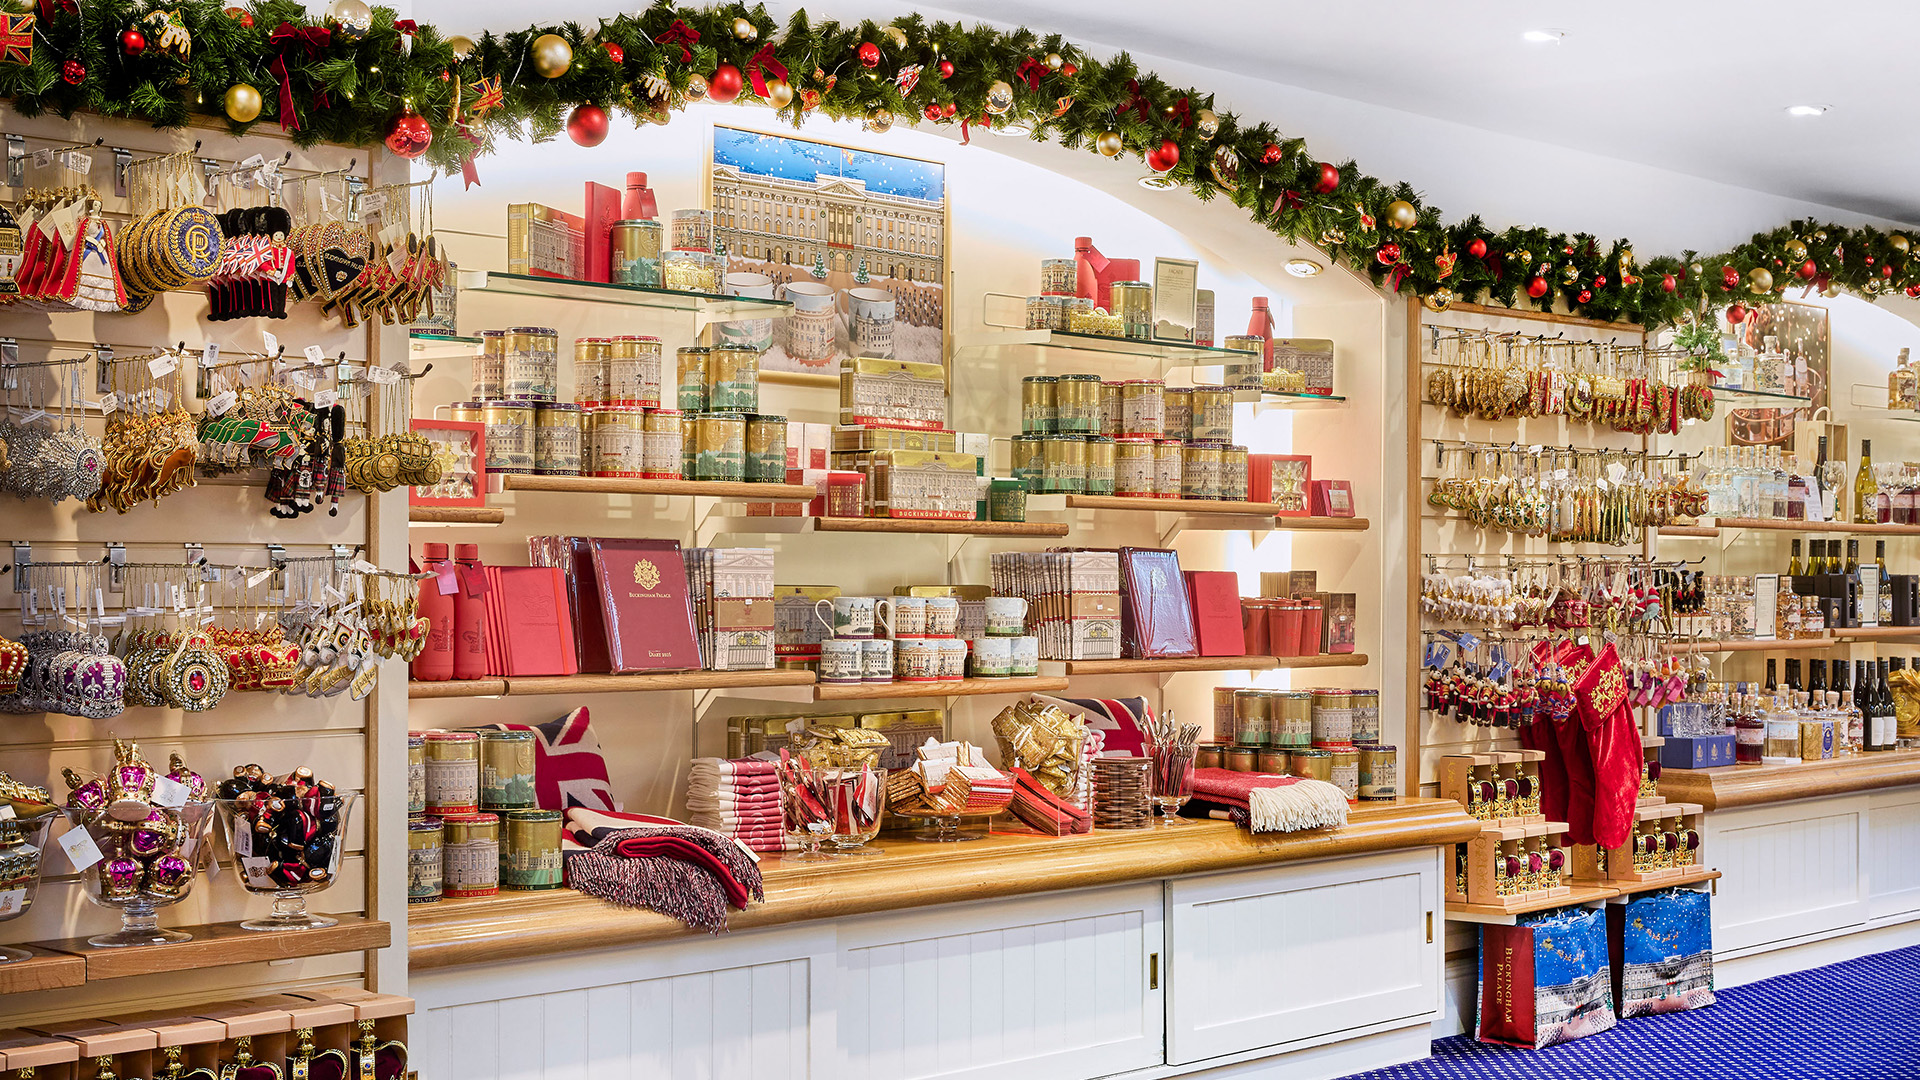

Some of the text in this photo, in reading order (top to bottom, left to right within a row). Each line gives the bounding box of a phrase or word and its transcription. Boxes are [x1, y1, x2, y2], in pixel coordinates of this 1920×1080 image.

[899, 510, 943, 518] BUCKINGHAM
[1496, 963, 1504, 1005] PALACE
[1505, 947, 1513, 1023] BUCKINGHAM
